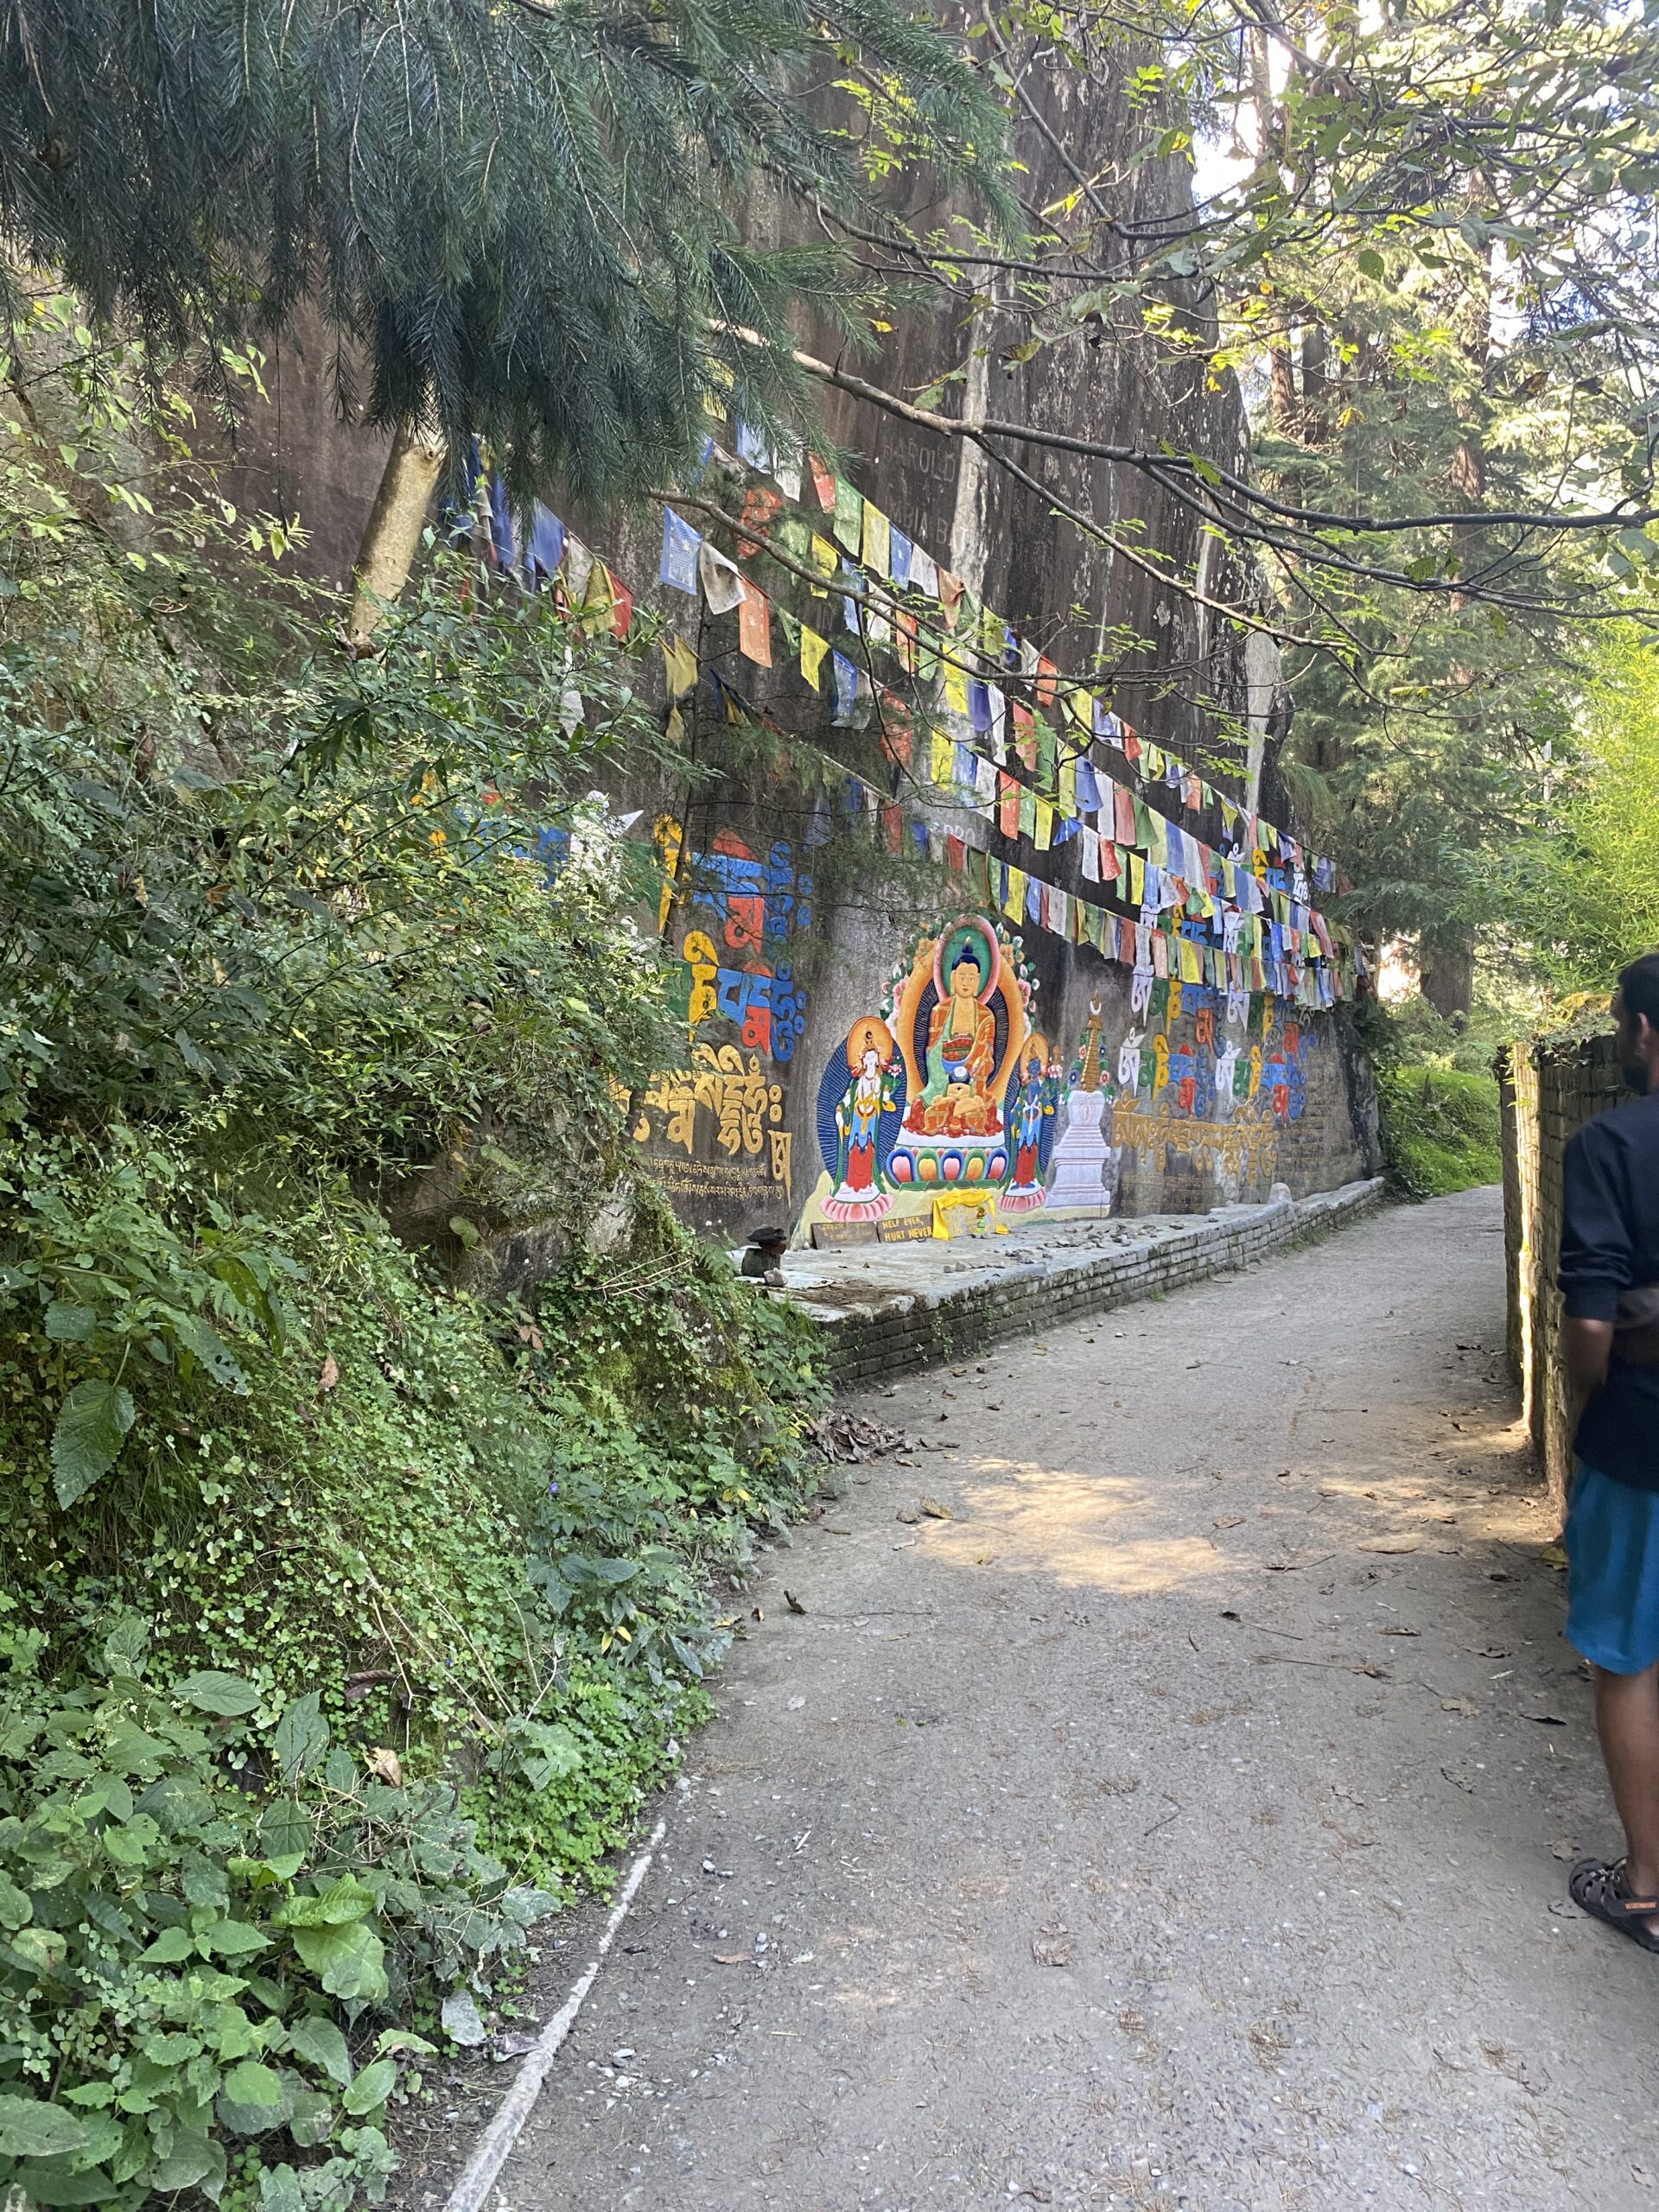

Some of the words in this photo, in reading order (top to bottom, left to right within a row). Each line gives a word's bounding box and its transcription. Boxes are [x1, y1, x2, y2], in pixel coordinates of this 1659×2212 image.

[883, 1217, 900, 1230] HELP
[884, 1230, 906, 1242] HURT
[909, 1225, 933, 1239] NEVER
